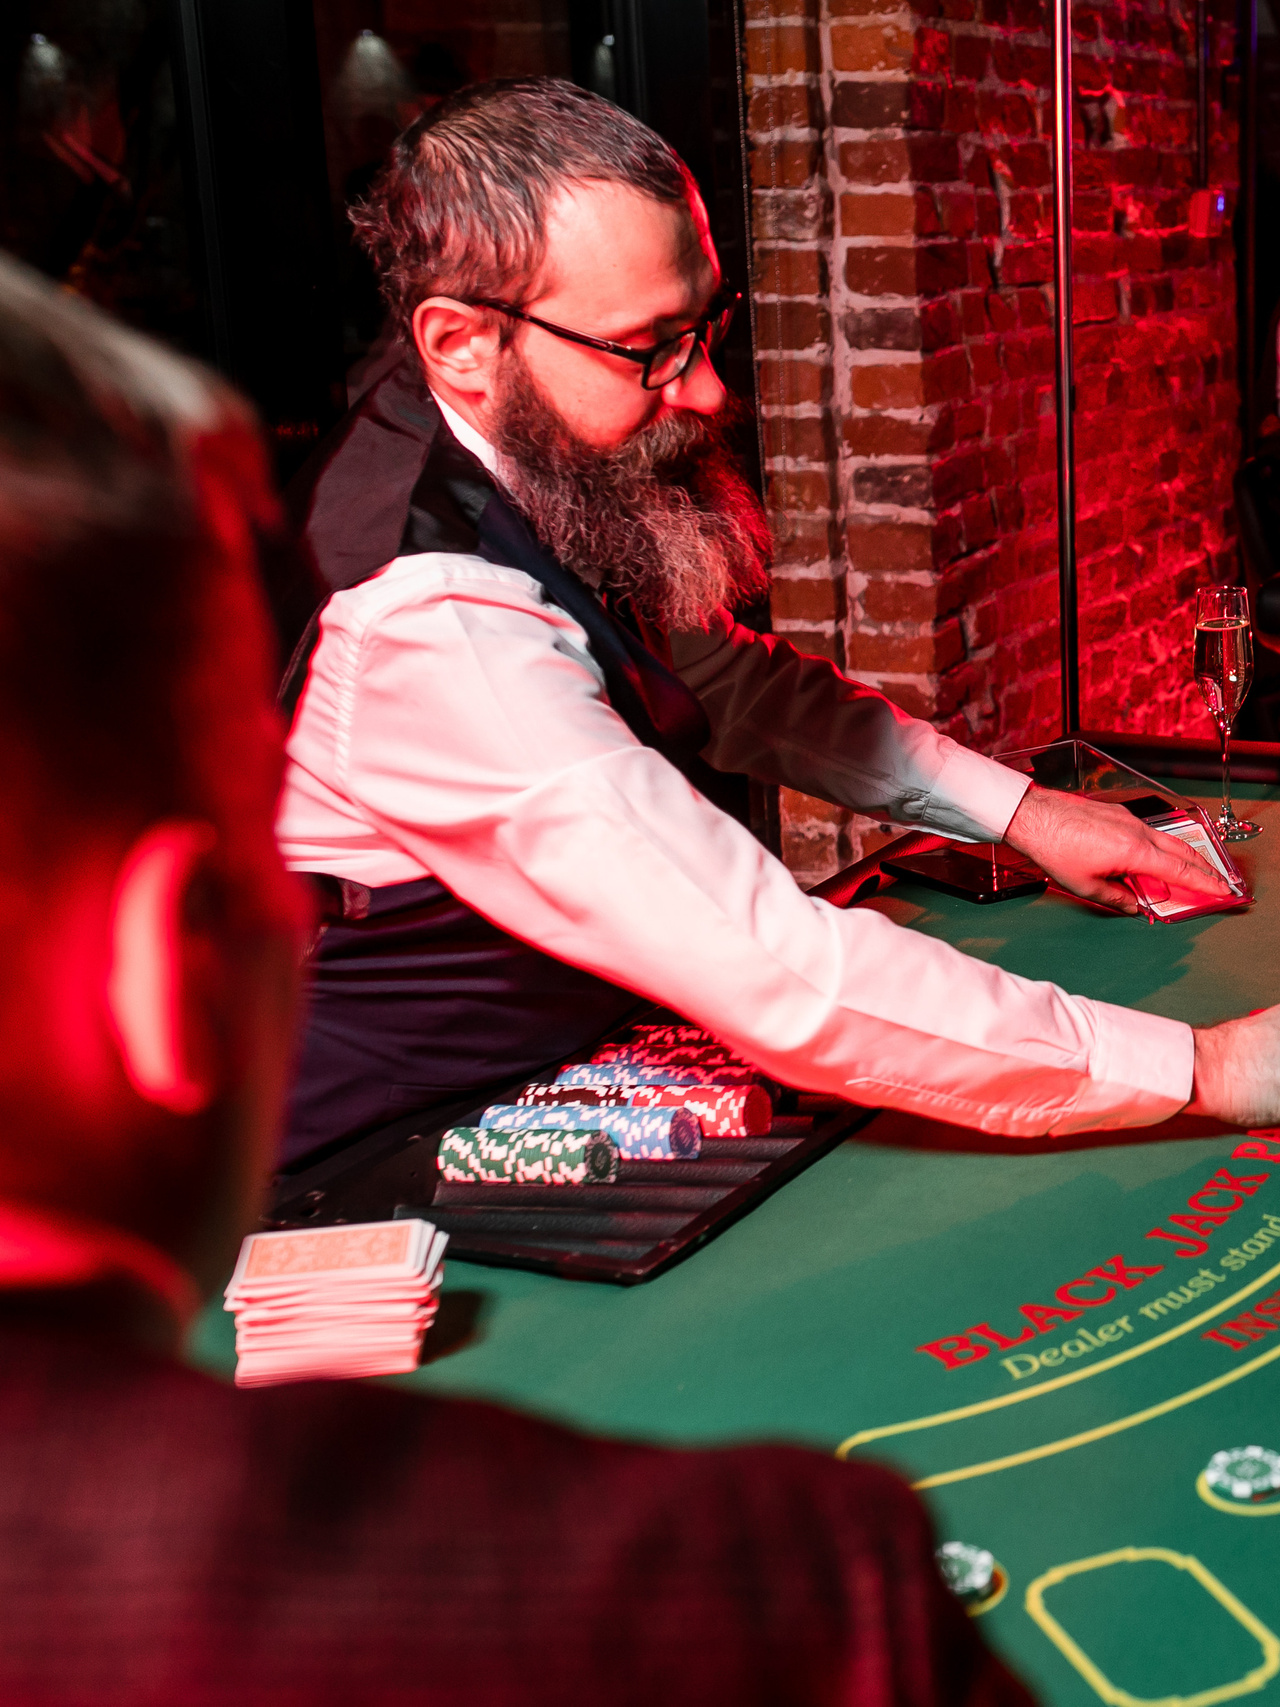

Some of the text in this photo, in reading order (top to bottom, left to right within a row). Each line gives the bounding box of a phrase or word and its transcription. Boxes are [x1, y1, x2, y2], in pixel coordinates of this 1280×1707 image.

[915, 1255, 1165, 1371] BLACK
[1145, 1168, 1270, 1258] JACK
[1001, 1315, 1135, 1380] Dealer
[1138, 1268, 1227, 1321] must
